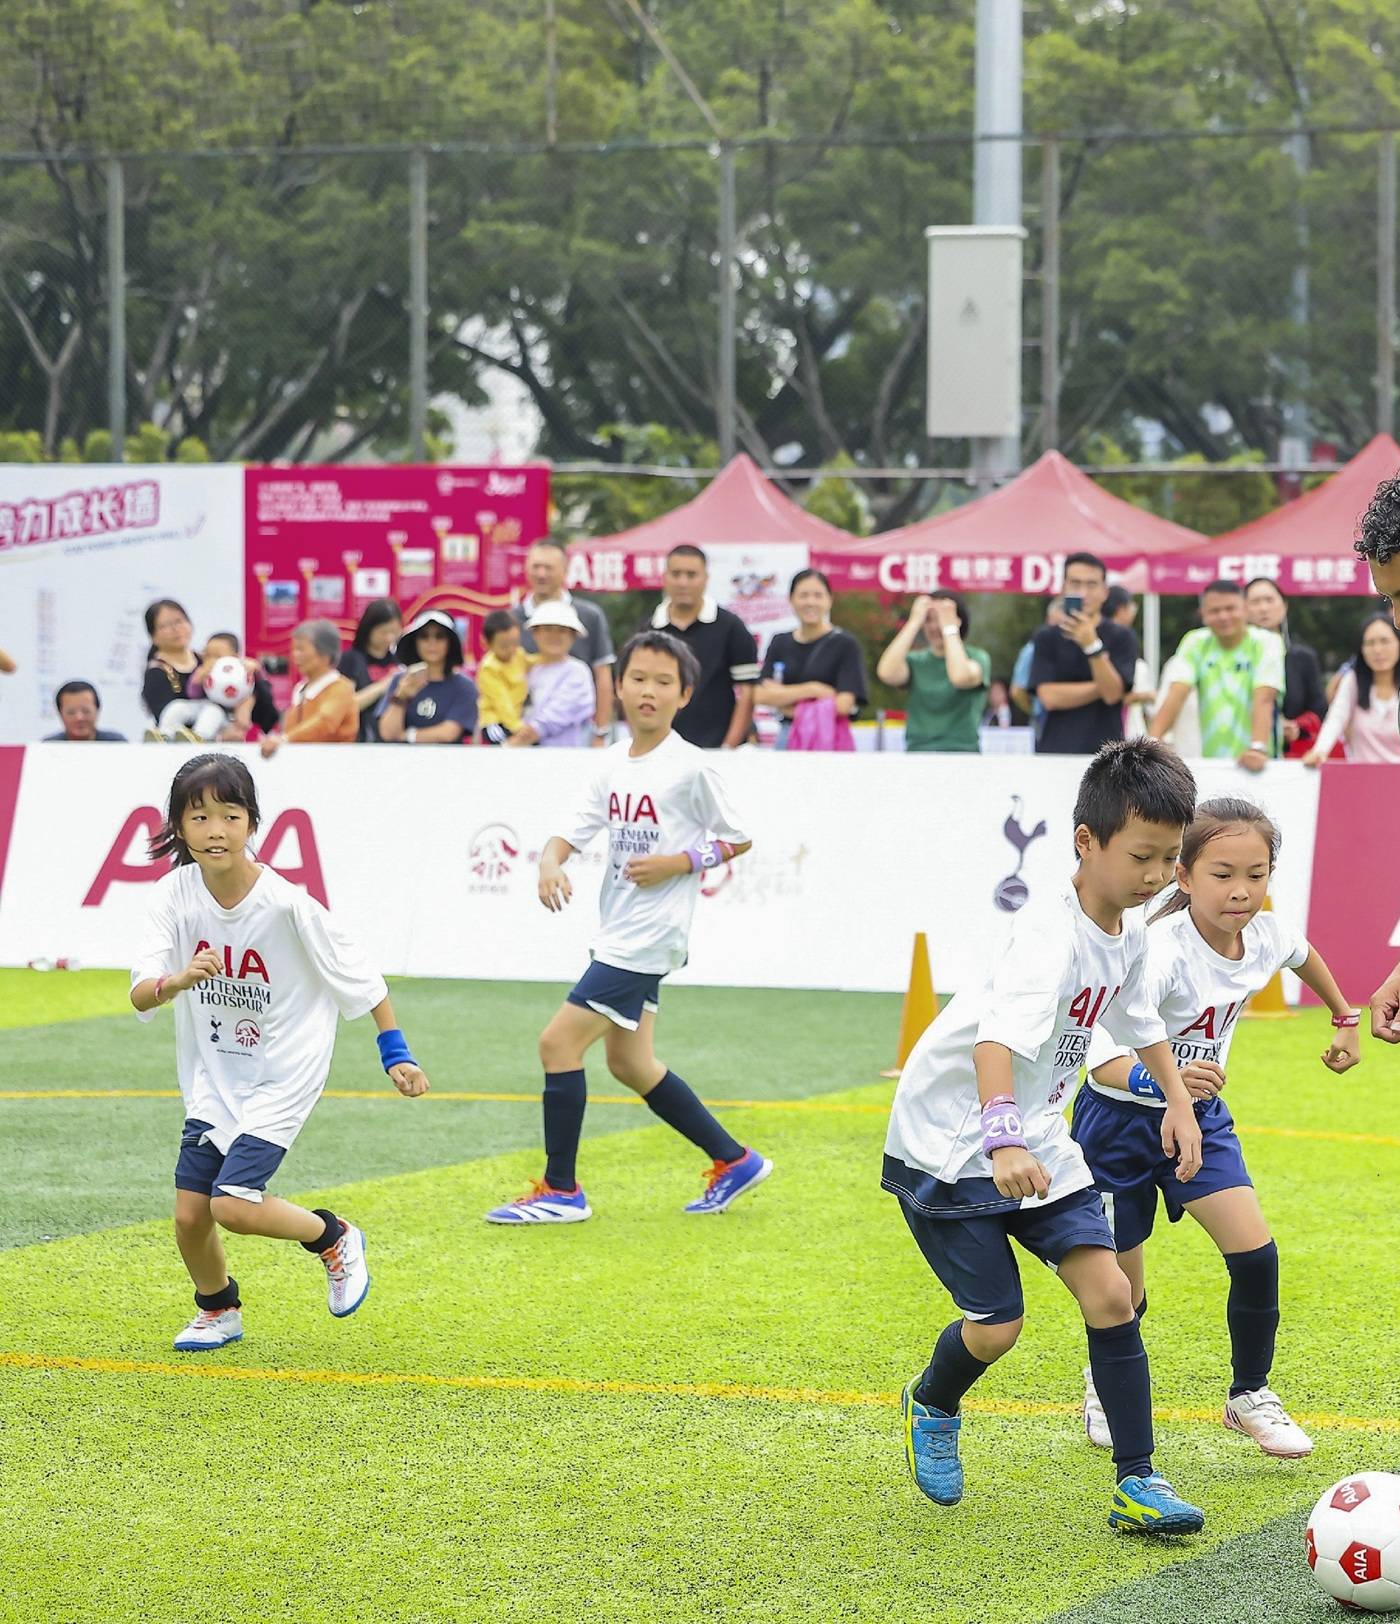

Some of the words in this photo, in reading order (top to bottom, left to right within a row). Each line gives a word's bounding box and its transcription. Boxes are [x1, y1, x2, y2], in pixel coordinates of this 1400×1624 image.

[608, 791, 659, 825] AIA
[82, 806, 331, 911] AA
[200, 991, 264, 1015] HOTSPUR
[235, 1036, 259, 1048] AIA
[1340, 1482, 1360, 1504] AIA
[1353, 1548, 1368, 1581] AIA
